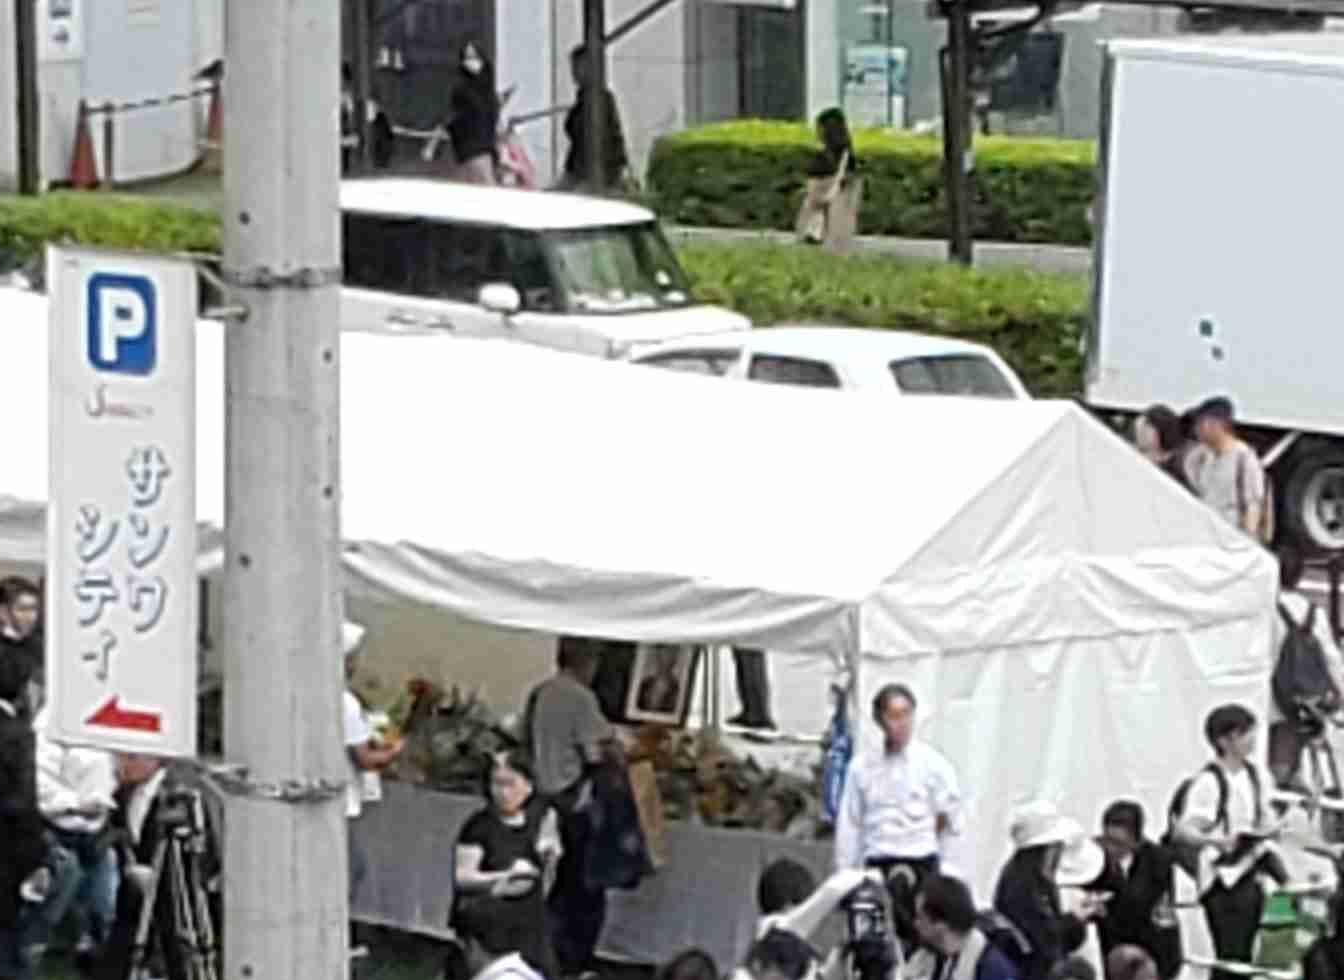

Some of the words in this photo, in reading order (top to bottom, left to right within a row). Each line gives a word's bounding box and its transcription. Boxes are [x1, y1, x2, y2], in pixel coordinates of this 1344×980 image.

[99, 287, 148, 364] P
[75, 505, 120, 682] シティ
[126, 443, 172, 633] サンワ
